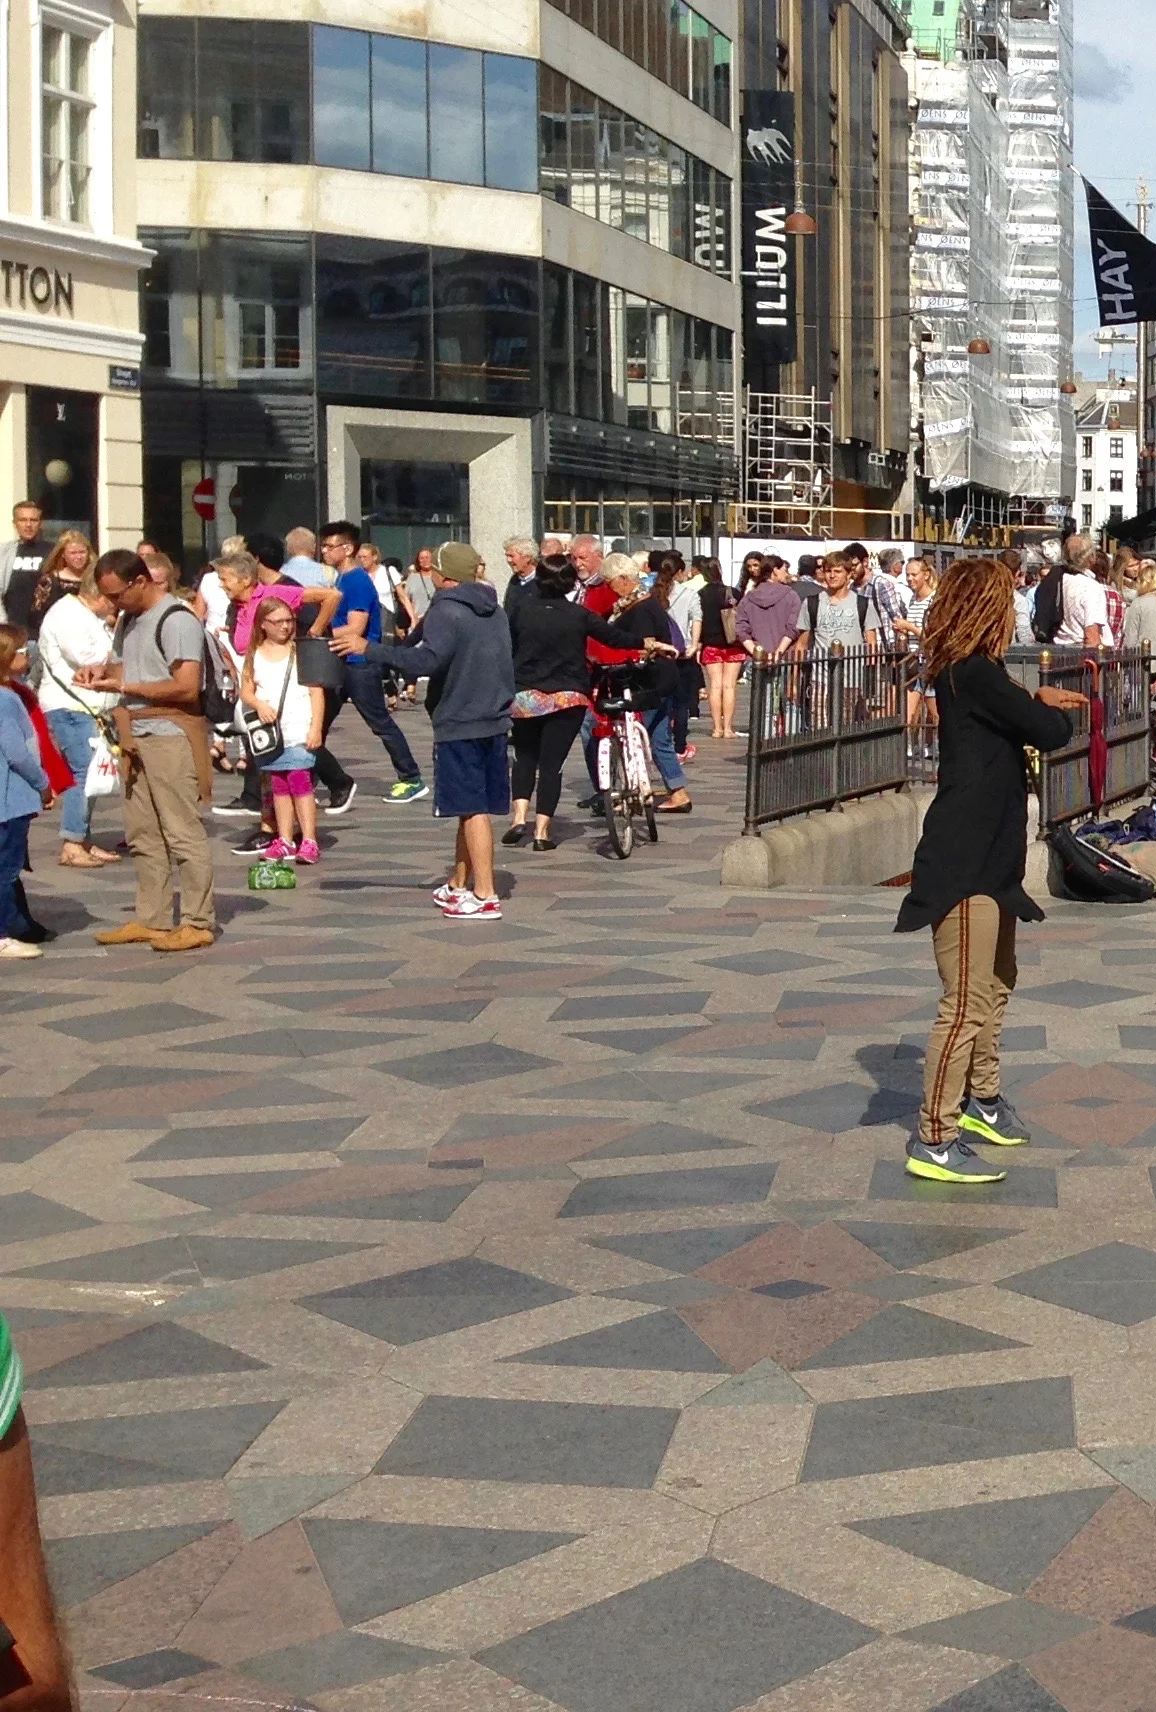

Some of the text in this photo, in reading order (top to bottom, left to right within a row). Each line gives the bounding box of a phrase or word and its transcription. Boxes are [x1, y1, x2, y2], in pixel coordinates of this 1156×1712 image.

[0, 260, 74, 314] TTON
[755, 207, 787, 326] ILLUM
[1096, 237, 1138, 321] HAY
